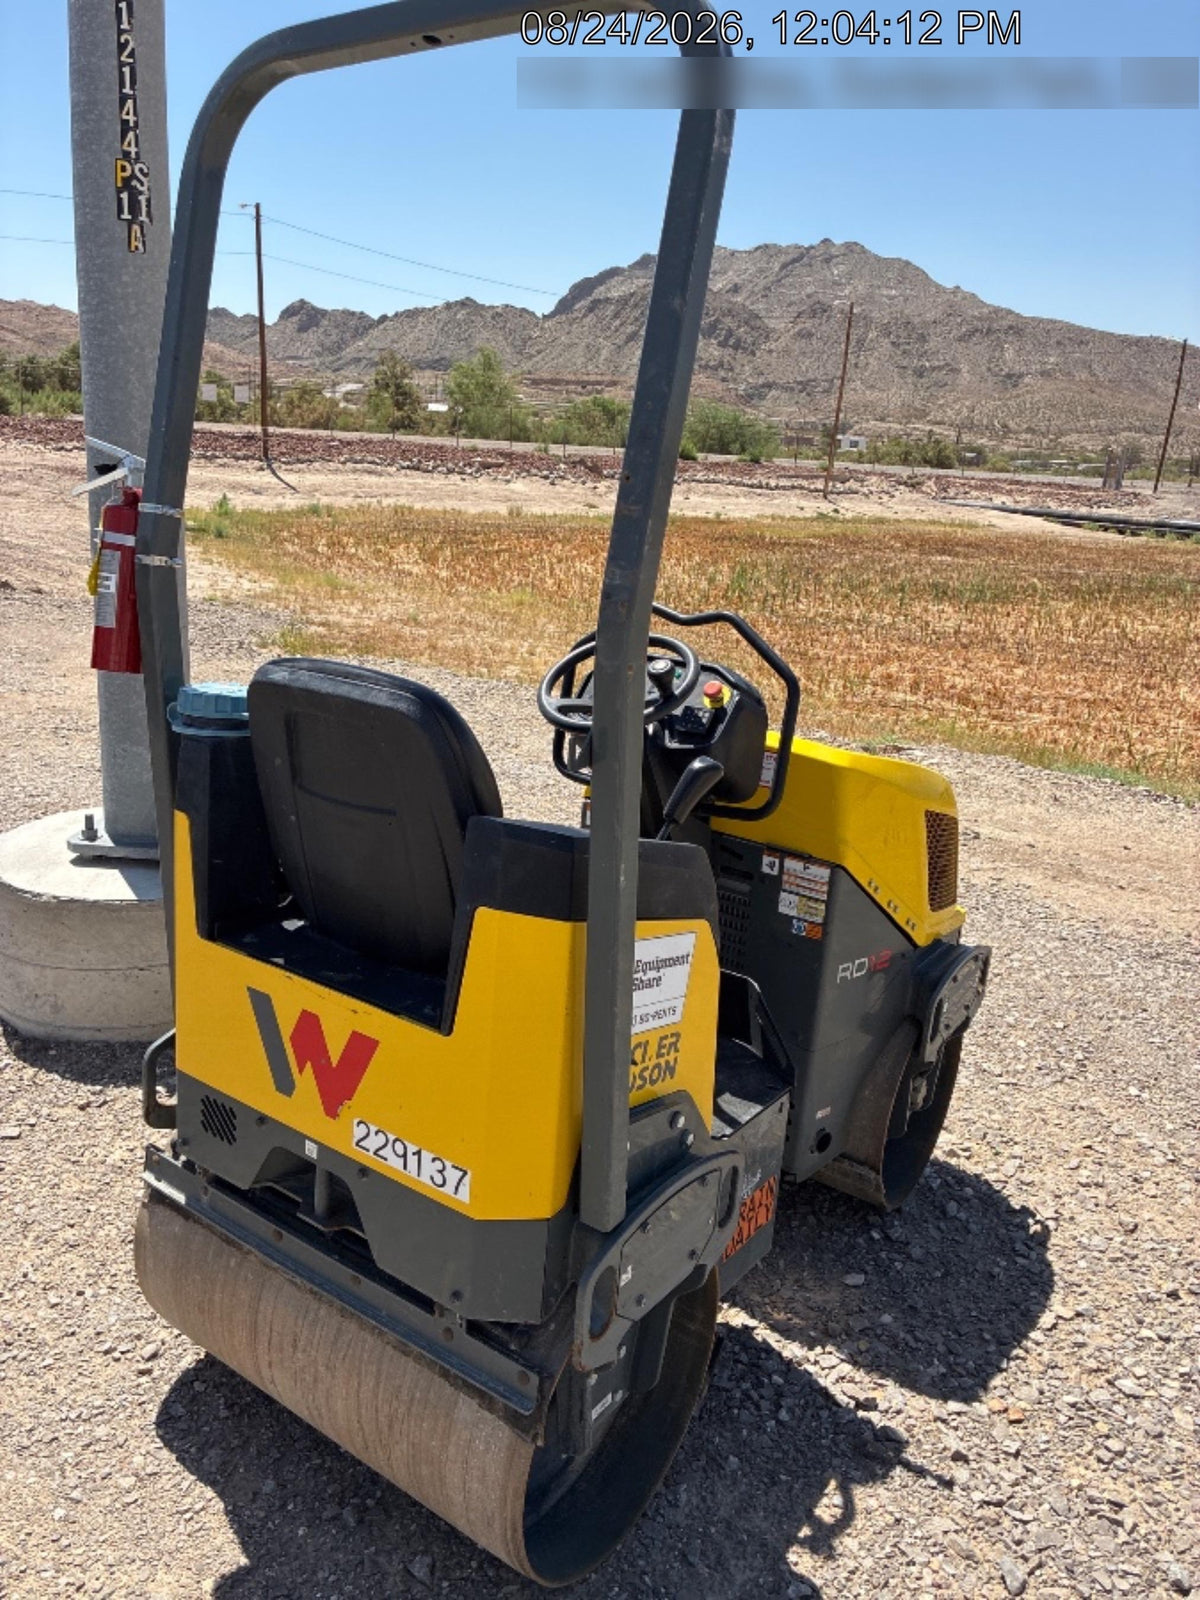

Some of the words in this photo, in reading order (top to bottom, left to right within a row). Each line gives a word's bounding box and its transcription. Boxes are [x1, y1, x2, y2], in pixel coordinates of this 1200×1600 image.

[635, 952, 690, 976] Equipment
[837, 949, 893, 984] RD12
[355, 1119, 468, 1196] 229137
